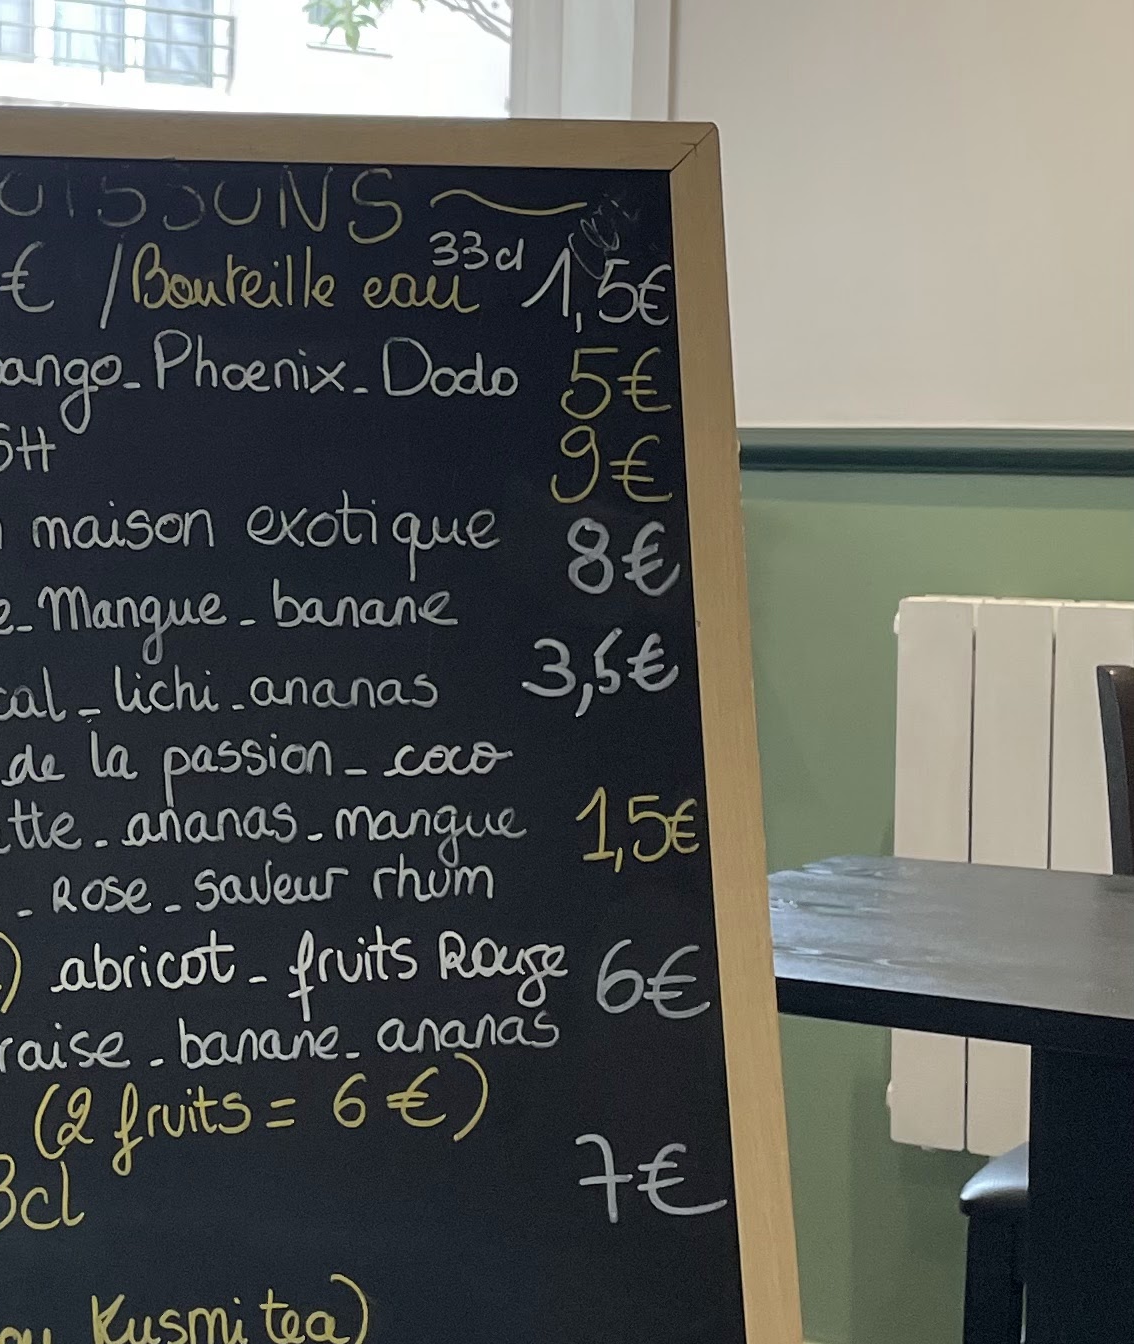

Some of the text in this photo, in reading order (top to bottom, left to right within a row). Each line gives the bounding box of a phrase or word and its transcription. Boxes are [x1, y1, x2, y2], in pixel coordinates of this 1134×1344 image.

[362, 272, 480, 314] eau
[521, 242, 670, 334] 1,5€
[382, 336, 519, 397] Dodo
[560, 346, 672, 420] 5€
[550, 425, 673, 504] 9€
[32, 500, 215, 551] maison
[566, 517, 680, 597] 8€
[272, 578, 459, 629] banane
[249, 673, 439, 709] ananas
[0, 743, 66, 787] de
[90, 730, 139, 780] la
[163, 732, 332, 808] passion
[383, 741, 514, 777] coco
[121, 801, 298, 847] ananas
[335, 804, 528, 868] mangue
[575, 786, 700, 873] 1,5€
[372, 852, 494, 902] rhum
[50, 929, 236, 993] abricot
[287, 924, 418, 1023] fruits
[596, 938, 711, 1019] 6€
[376, 1009, 560, 1054] ananas
[575, 1133, 728, 1224] 7€
